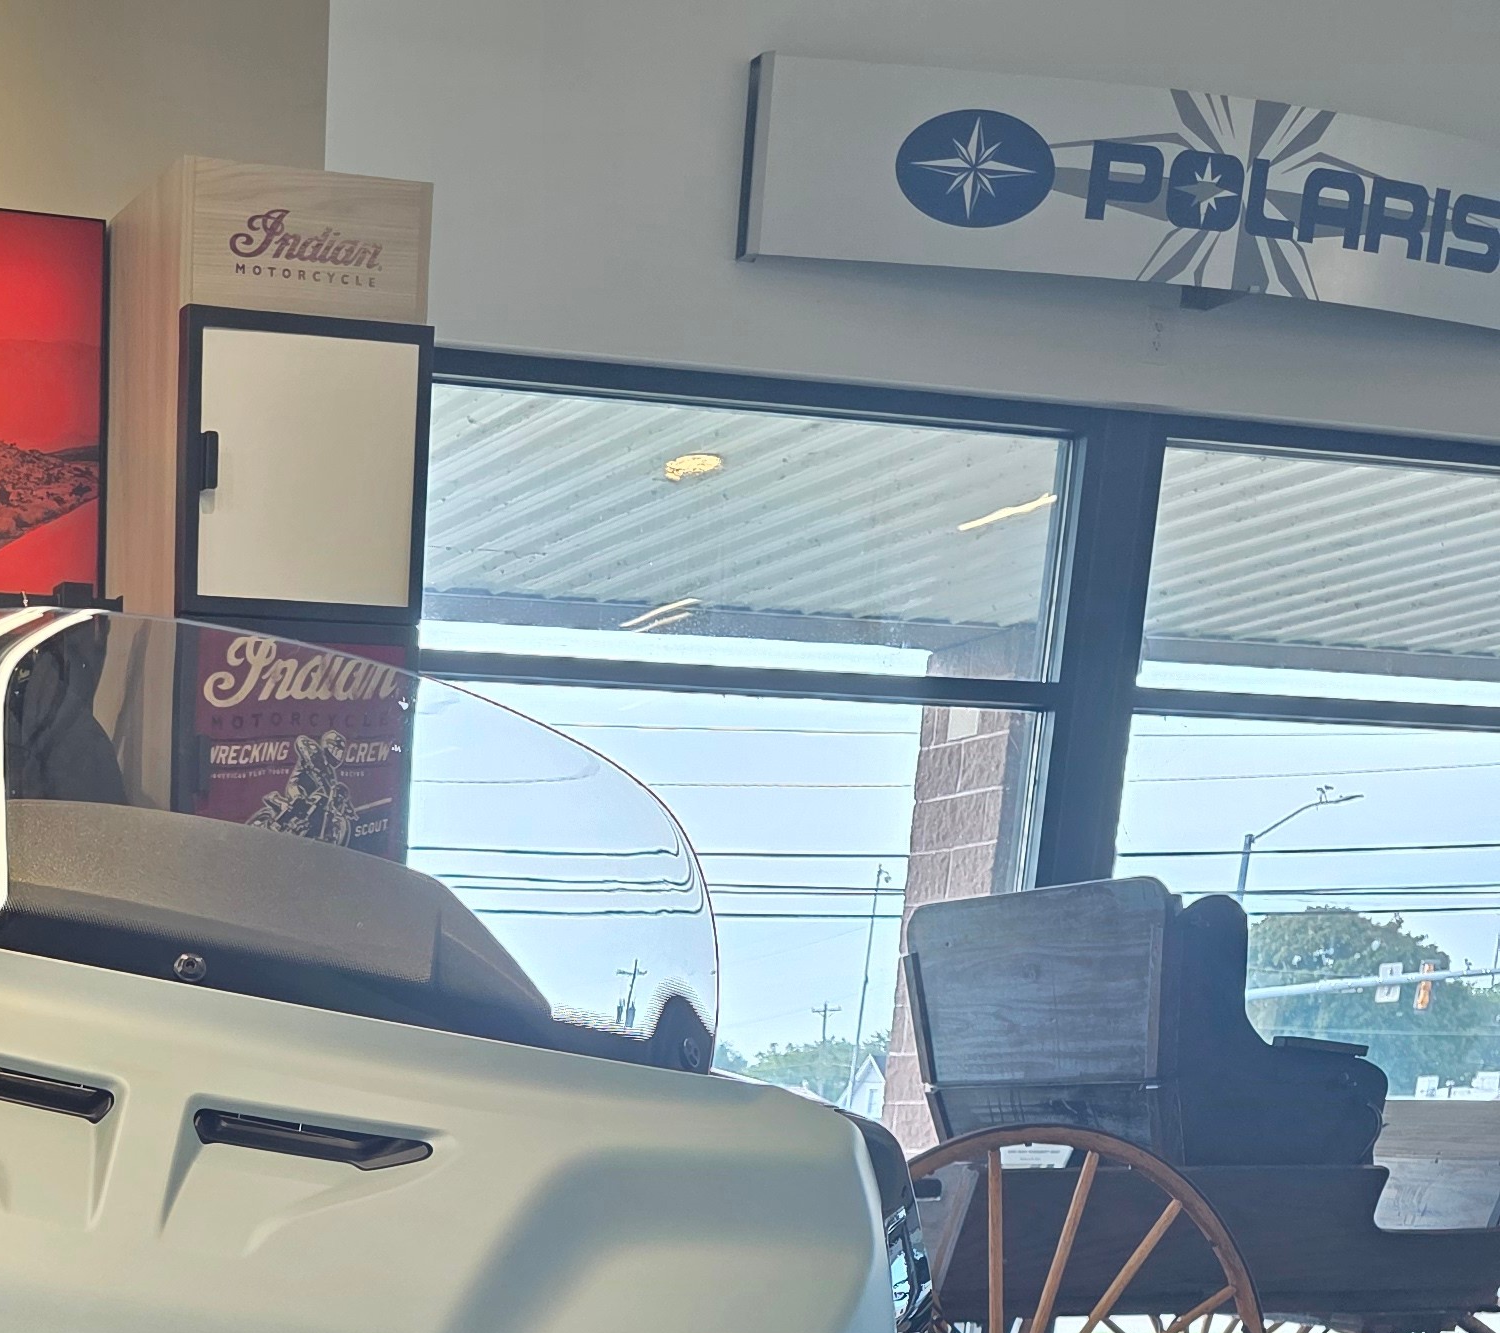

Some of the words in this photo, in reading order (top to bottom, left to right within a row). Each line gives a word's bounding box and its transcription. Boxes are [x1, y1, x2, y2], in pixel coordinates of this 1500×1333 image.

[1084, 139, 1500, 275] POLARIS
[229, 208, 382, 271] Indian
[234, 262, 377, 289] MOTORCYCLE
[203, 636, 399, 708] Indian
[345, 741, 391, 763] CREW
[355, 818, 389, 838] SCOUT
